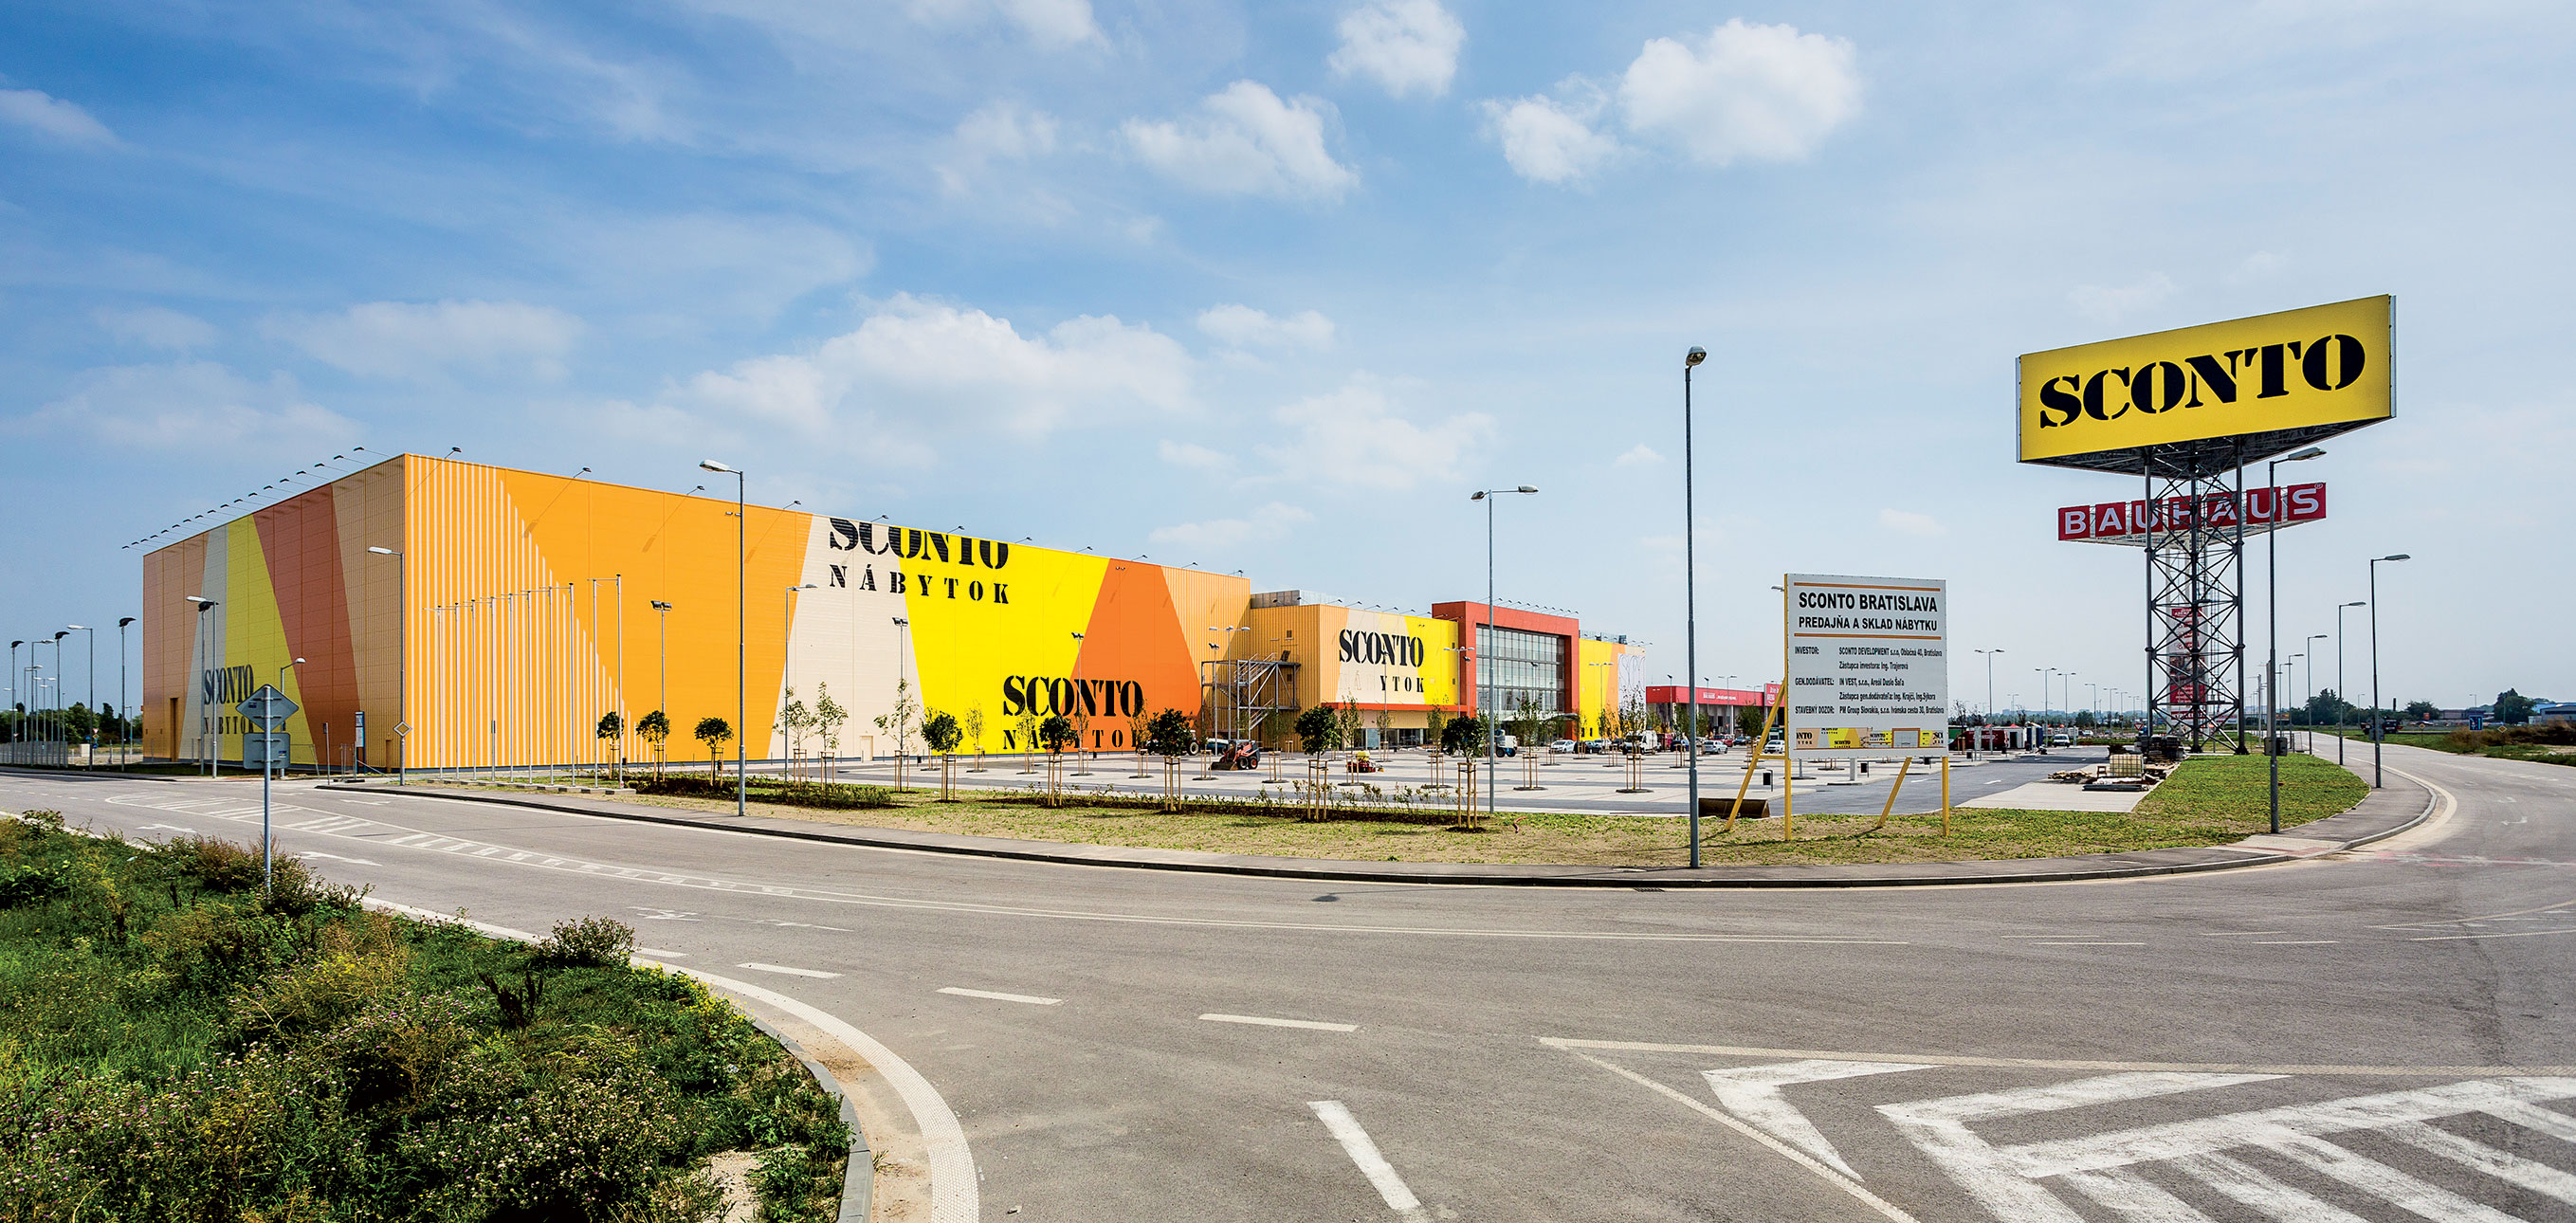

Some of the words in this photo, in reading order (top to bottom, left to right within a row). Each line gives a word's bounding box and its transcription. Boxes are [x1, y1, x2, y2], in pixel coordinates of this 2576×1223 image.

[2040, 334, 2366, 429] SCONTO
[2065, 487, 2320, 535] BAUHAUS
[830, 564, 1009, 605] NÁBYTOK
[1799, 592, 1855, 610] SCONTO
[1859, 593, 1938, 612] BRATISLAVA
[1799, 614, 1851, 630] PREDAJŇA
[1853, 617, 1859, 630] A
[1862, 617, 1893, 630] SKLAD
[1895, 617, 1938, 631] NÁBYTKU
[1339, 629, 1424, 668] SCONTO
[1795, 647, 1819, 655] INVESTOR:
[1858, 648, 1890, 656] DEVELOPMENT
[1003, 675, 1144, 718] SCONTO
